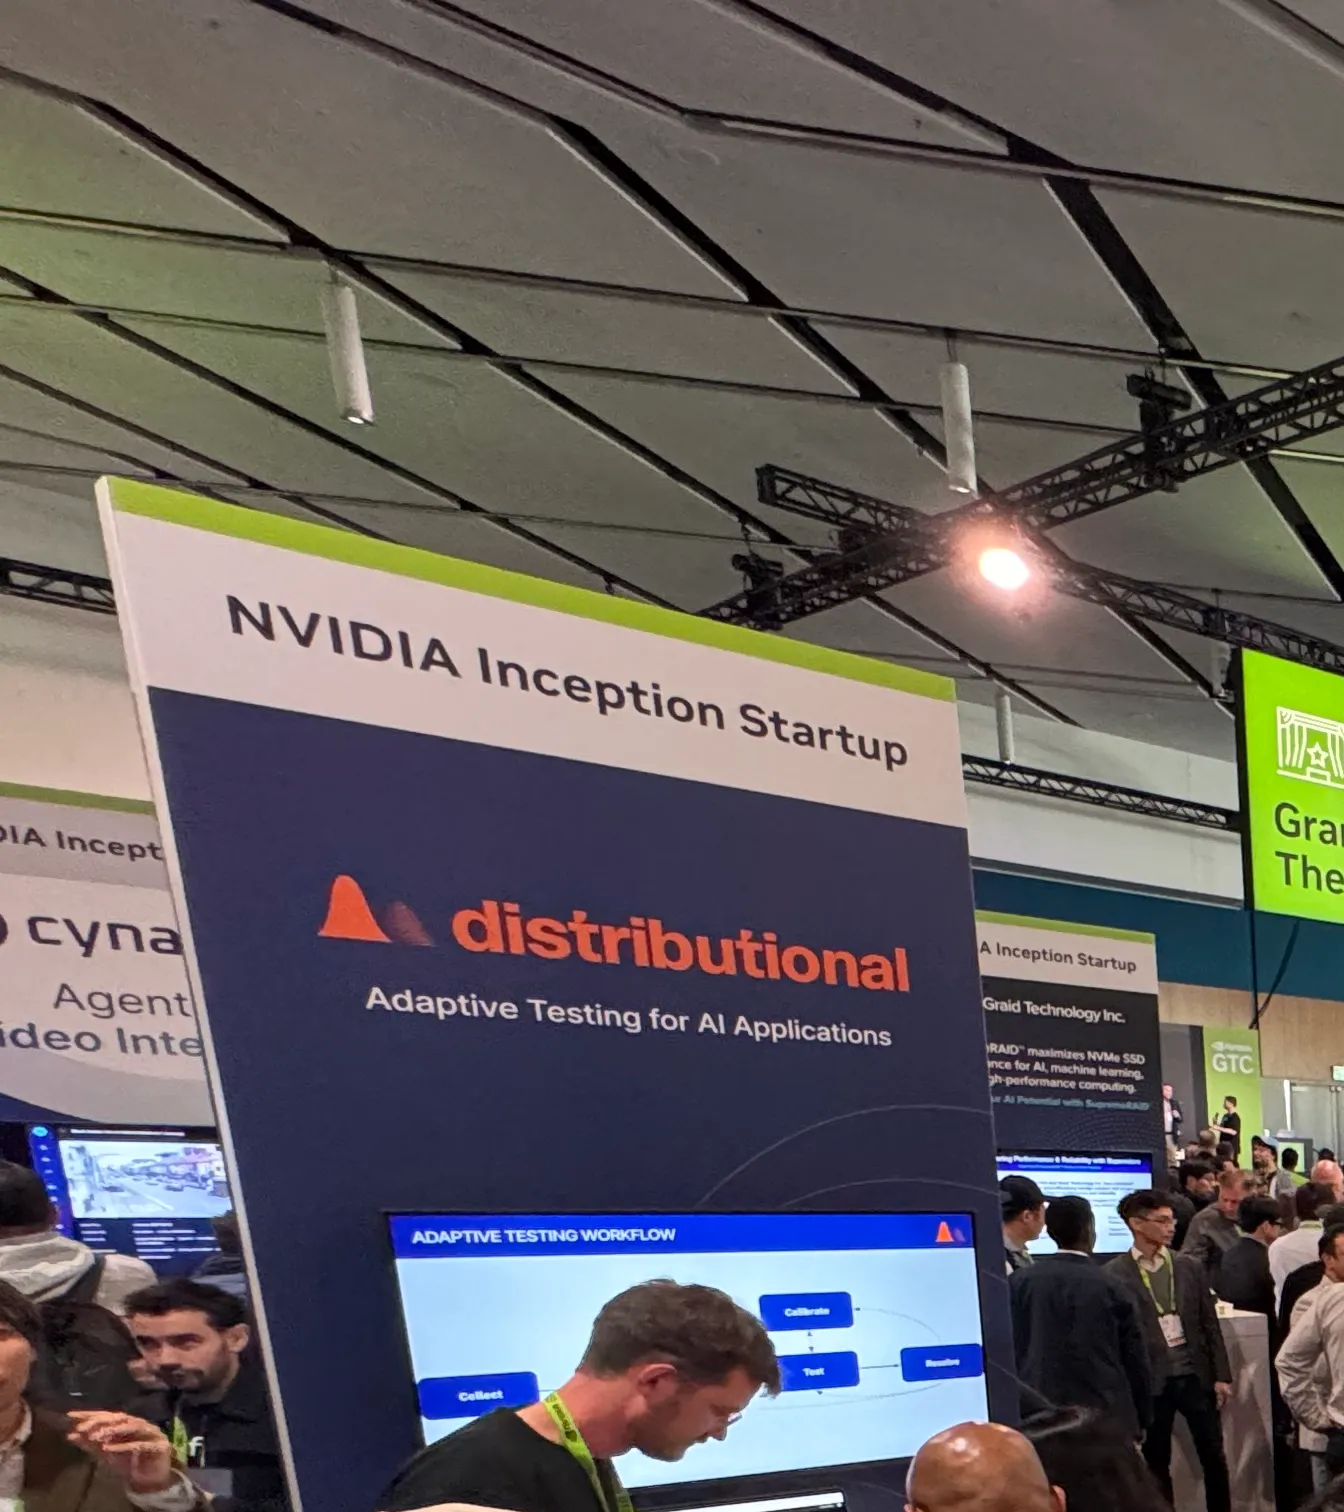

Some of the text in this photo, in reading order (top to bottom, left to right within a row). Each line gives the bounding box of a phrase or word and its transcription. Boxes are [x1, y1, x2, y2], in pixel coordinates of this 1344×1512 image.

[226, 594, 908, 772] NVIDIA Inception Startup
[56, 830, 165, 862] Incept
[451, 899, 911, 993] distributional
[996, 942, 1073, 965] Inception
[1077, 953, 1137, 974] Startup
[53, 983, 192, 1019] Agent
[982, 997, 1126, 1024] Graid Technology Inc.
[365, 986, 893, 1047] Adaptive Testing for AI Applications
[1027, 1047, 1085, 1061] maximizes
[1123, 1053, 1146, 1065] SSD
[1051, 1062, 1096, 1075] machine
[1212, 1053, 1254, 1074] GTC
[412, 1228, 676, 1244] ADAPTIVE TESTING WORKFLOW
[802, 1367, 825, 1377] Test
[458, 1390, 504, 1402] Collect
